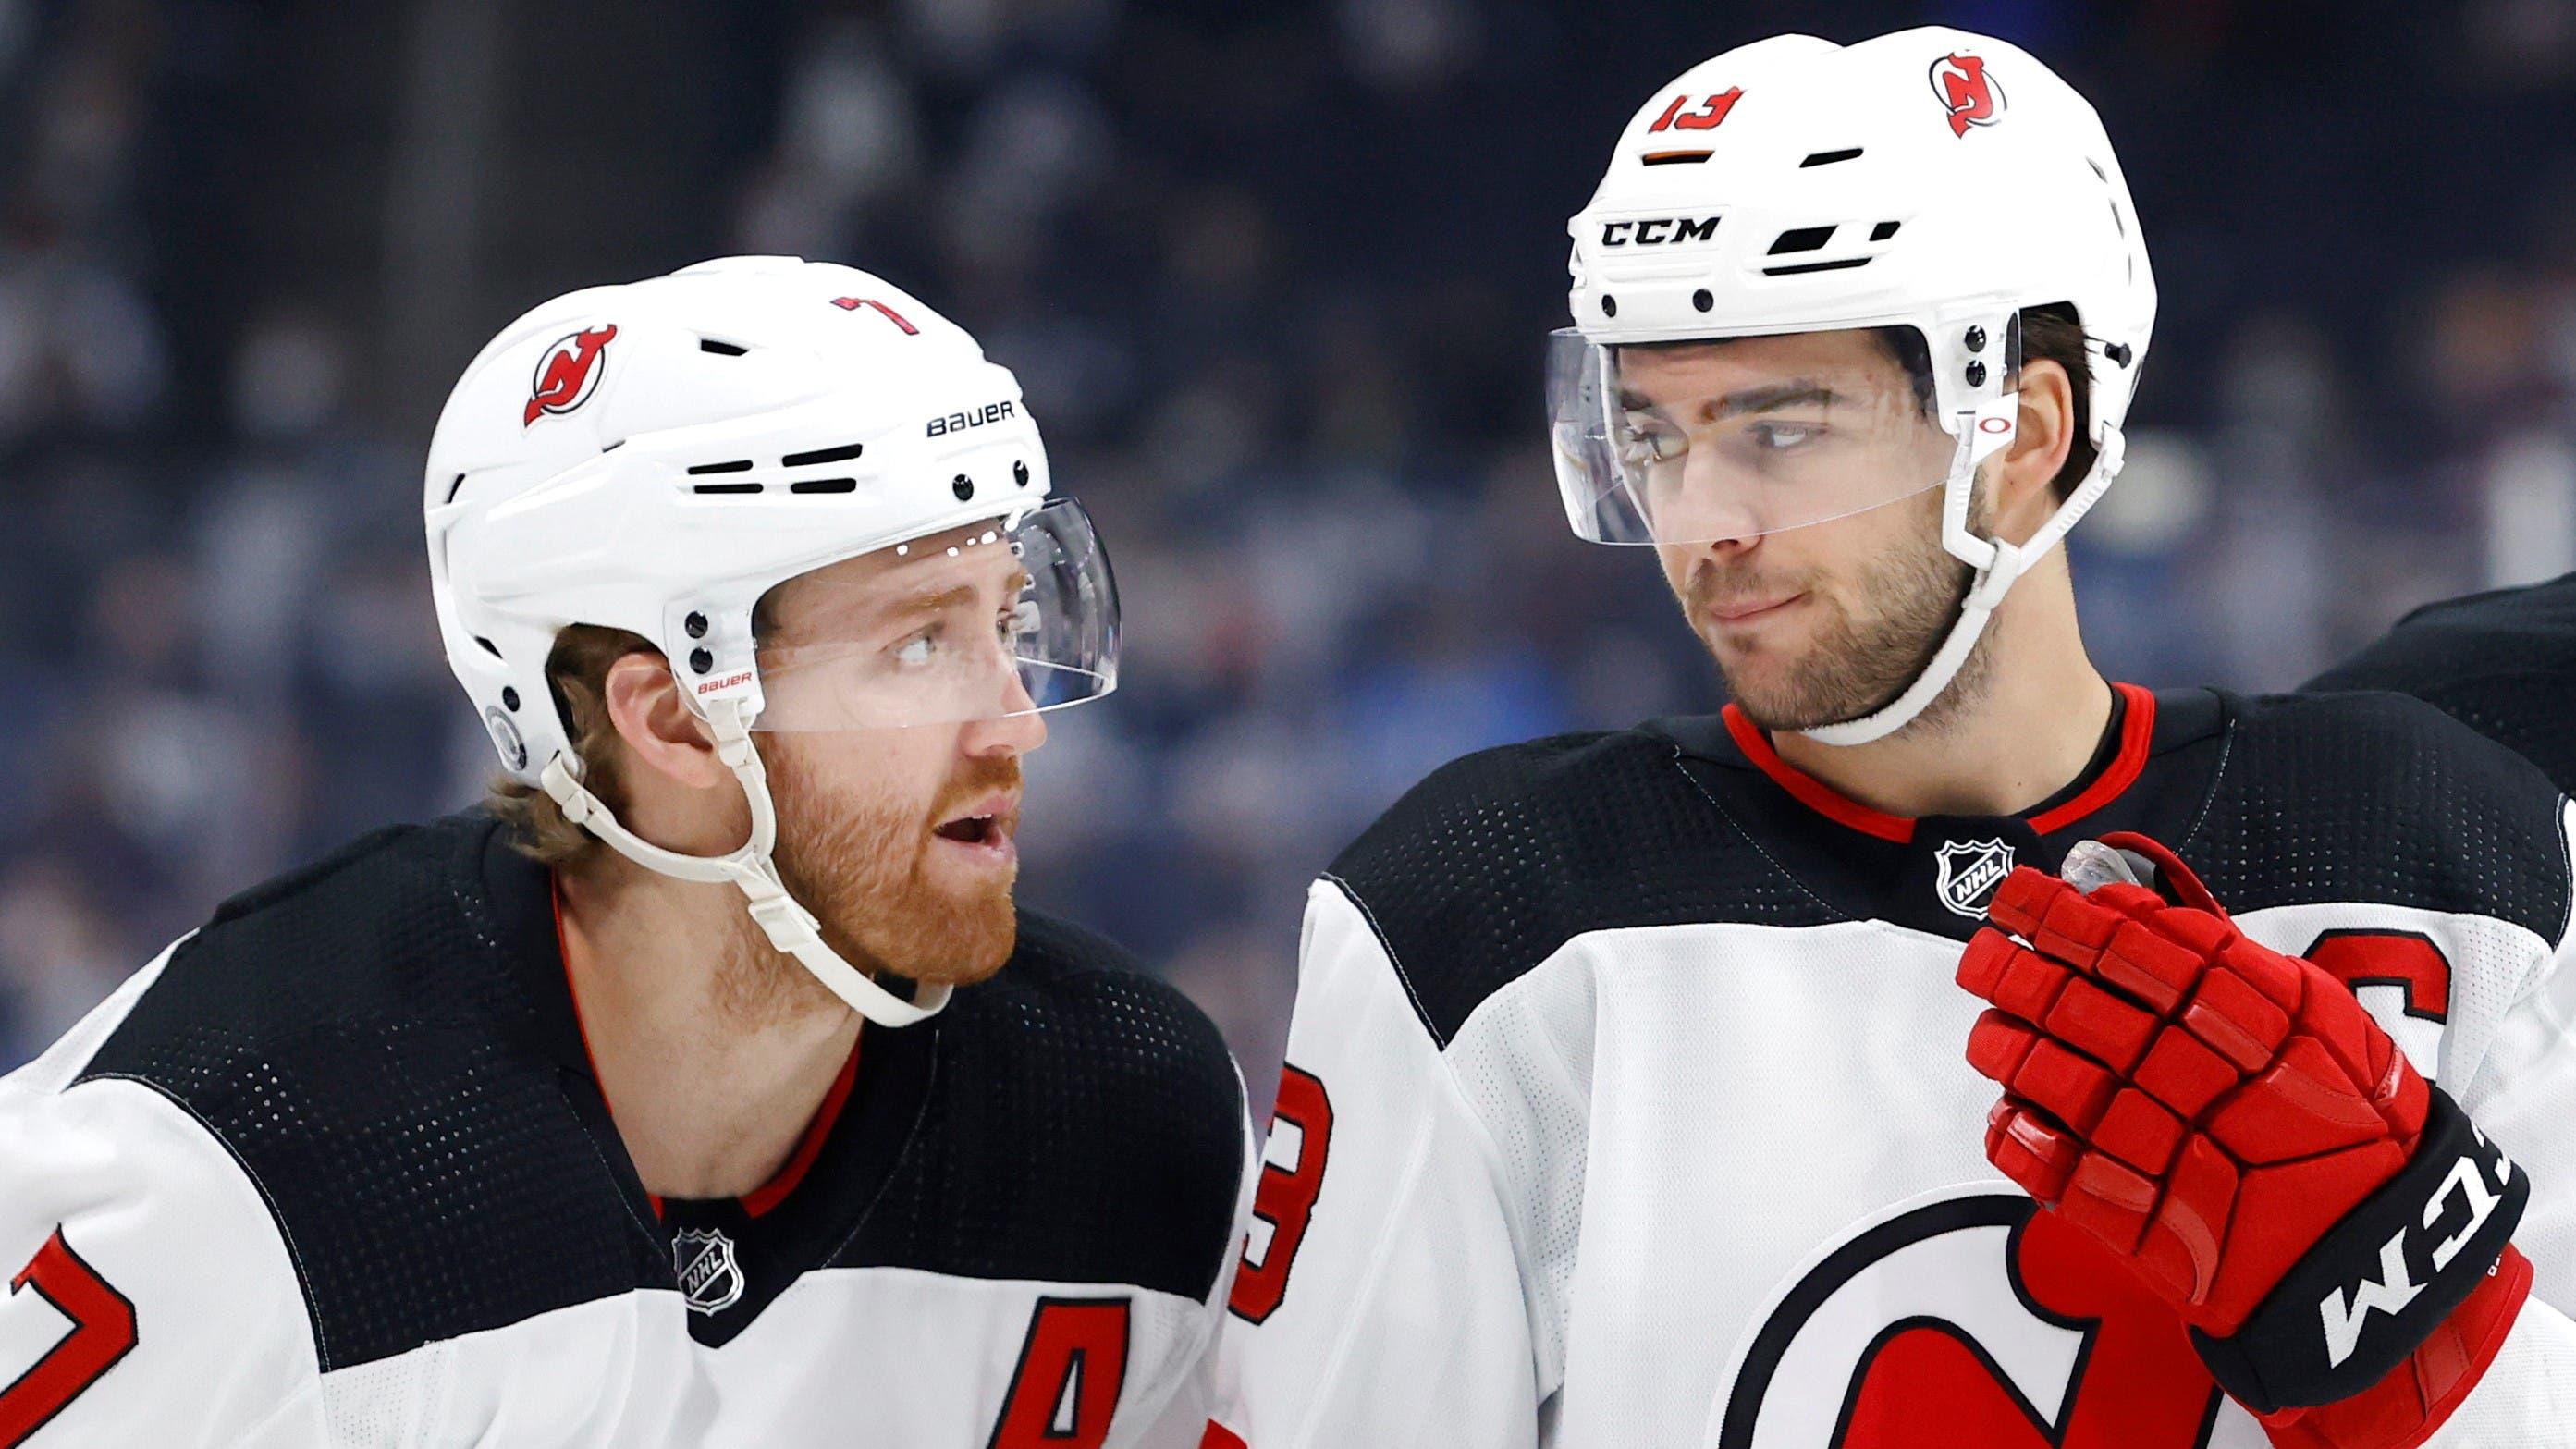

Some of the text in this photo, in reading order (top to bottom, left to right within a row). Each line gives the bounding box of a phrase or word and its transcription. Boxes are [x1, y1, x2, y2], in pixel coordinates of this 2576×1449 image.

[1648, 86, 1747, 134] 13
[1601, 216, 1722, 246] CCM
[830, 296, 920, 336] 7
[1956, 859, 2000, 902] NHL
[687, 1251, 722, 1295] NHL
[0, 1222, 139, 1449] 7
[987, 1296, 1131, 1449] A
